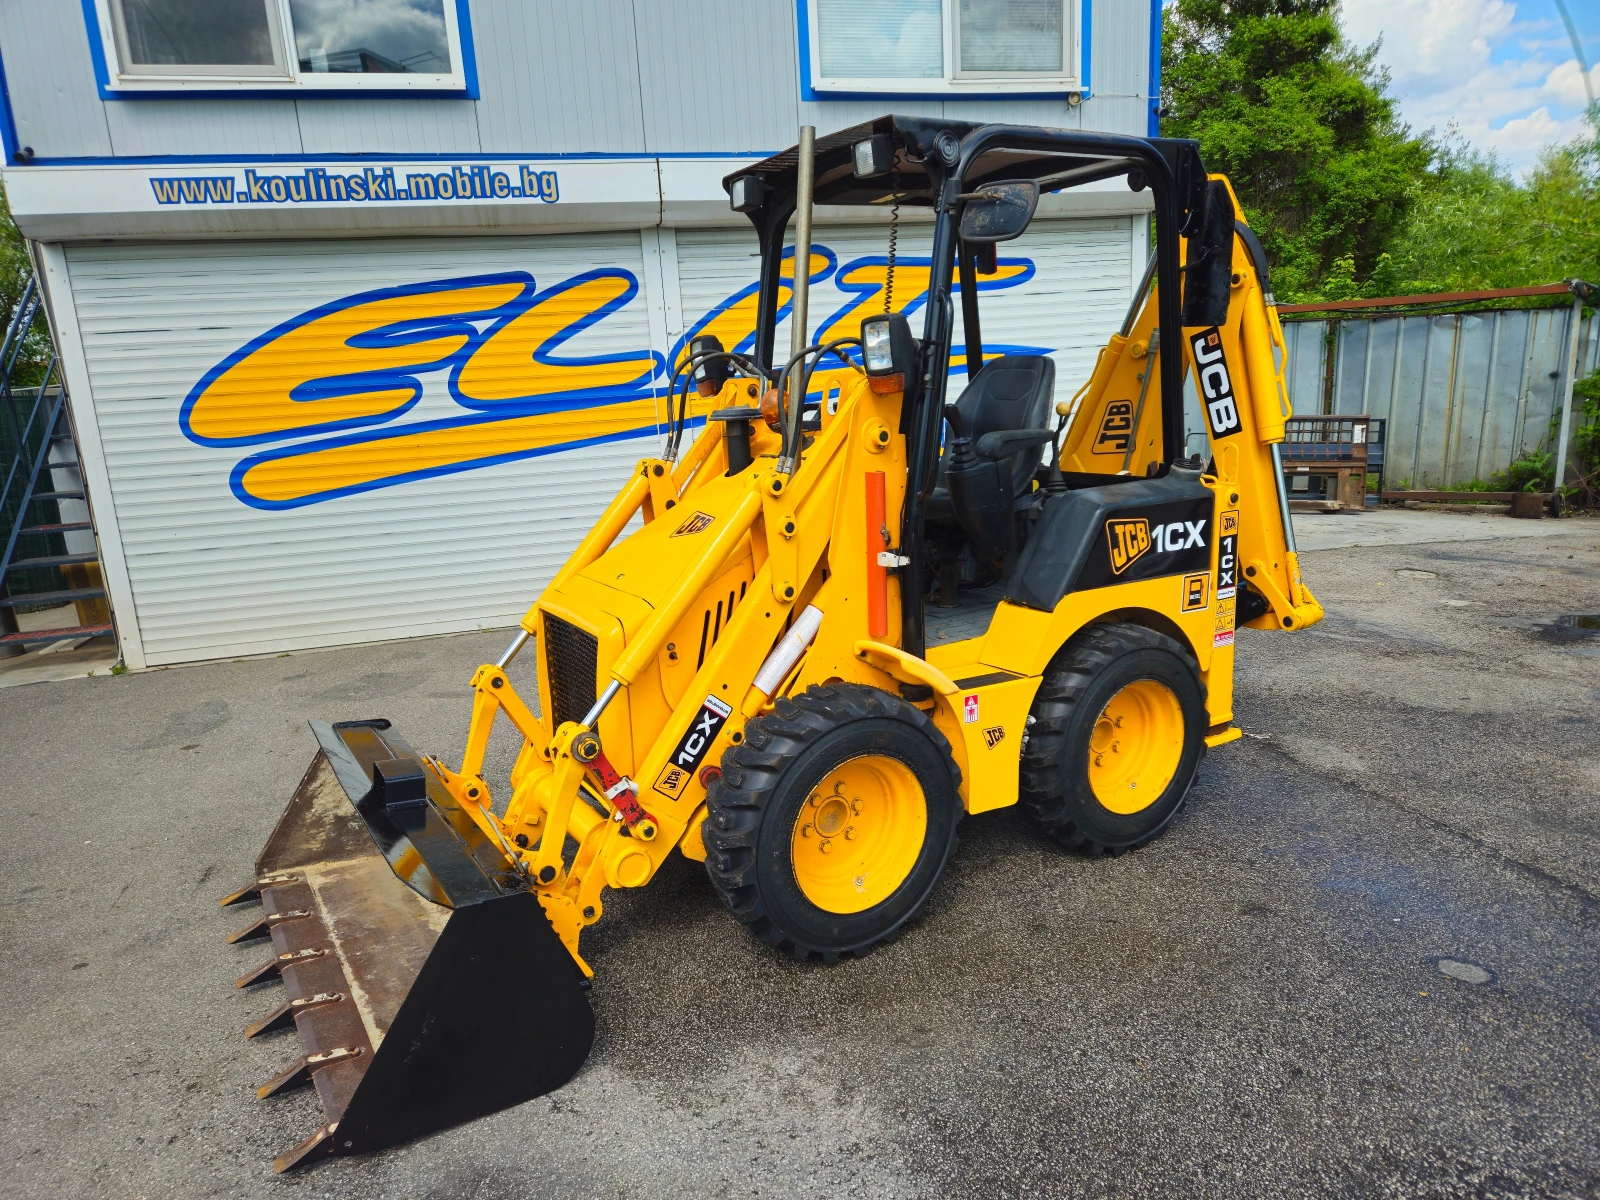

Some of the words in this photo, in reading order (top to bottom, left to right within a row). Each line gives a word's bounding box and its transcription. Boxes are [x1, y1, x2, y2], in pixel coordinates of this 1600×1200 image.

[149, 165, 560, 205] www.koulinski.mobile.bg
[1194, 338, 1238, 433] JCB
[1099, 404, 1131, 450] JCB
[674, 514, 712, 535] JCB
[1113, 523, 1148, 568] JCB
[1151, 520, 1206, 553] 1CX
[1220, 537, 1234, 586] 1CX
[663, 770, 681, 789] JCB
[678, 710, 720, 765] 1CX
[986, 728, 1004, 747] JCB
